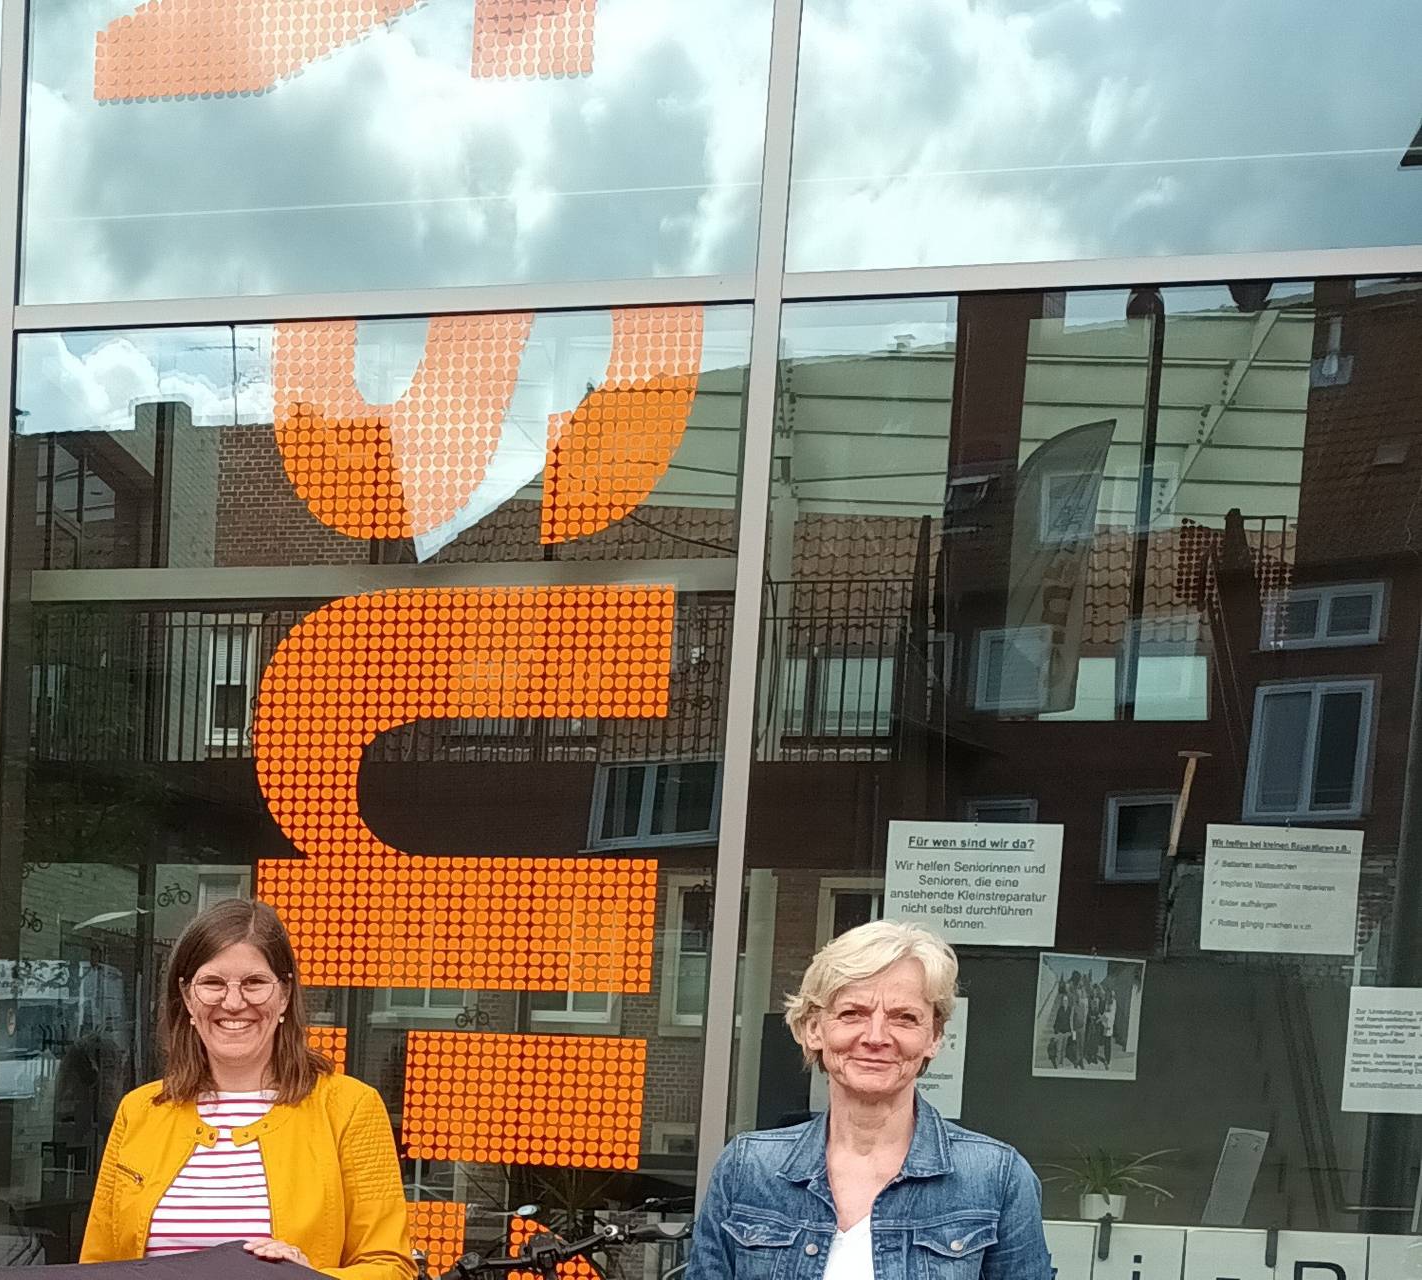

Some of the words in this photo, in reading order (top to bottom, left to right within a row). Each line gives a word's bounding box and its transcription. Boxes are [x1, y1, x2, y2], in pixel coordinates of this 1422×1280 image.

[908, 836, 928, 848] Für
[932, 839, 957, 848] wen
[960, 838, 987, 849] sind
[990, 838, 1009, 849] wir
[1012, 838, 1035, 850] da?
[895, 860, 913, 871] Wir
[917, 860, 951, 872] helfen
[954, 861, 1021, 874] Seniorinnen
[1024, 863, 1046, 874] und
[918, 874, 971, 887] Senioren,
[975, 876, 992, 887] die
[995, 878, 1019, 888] eine
[890, 889, 955, 900] anstehende
[957, 890, 1047, 903] Kleinstreparatur
[901, 903, 927, 914] nicht
[930, 904, 963, 915] selbst
[966, 905, 1033, 917] durchführen
[943, 918, 987, 930] können.
